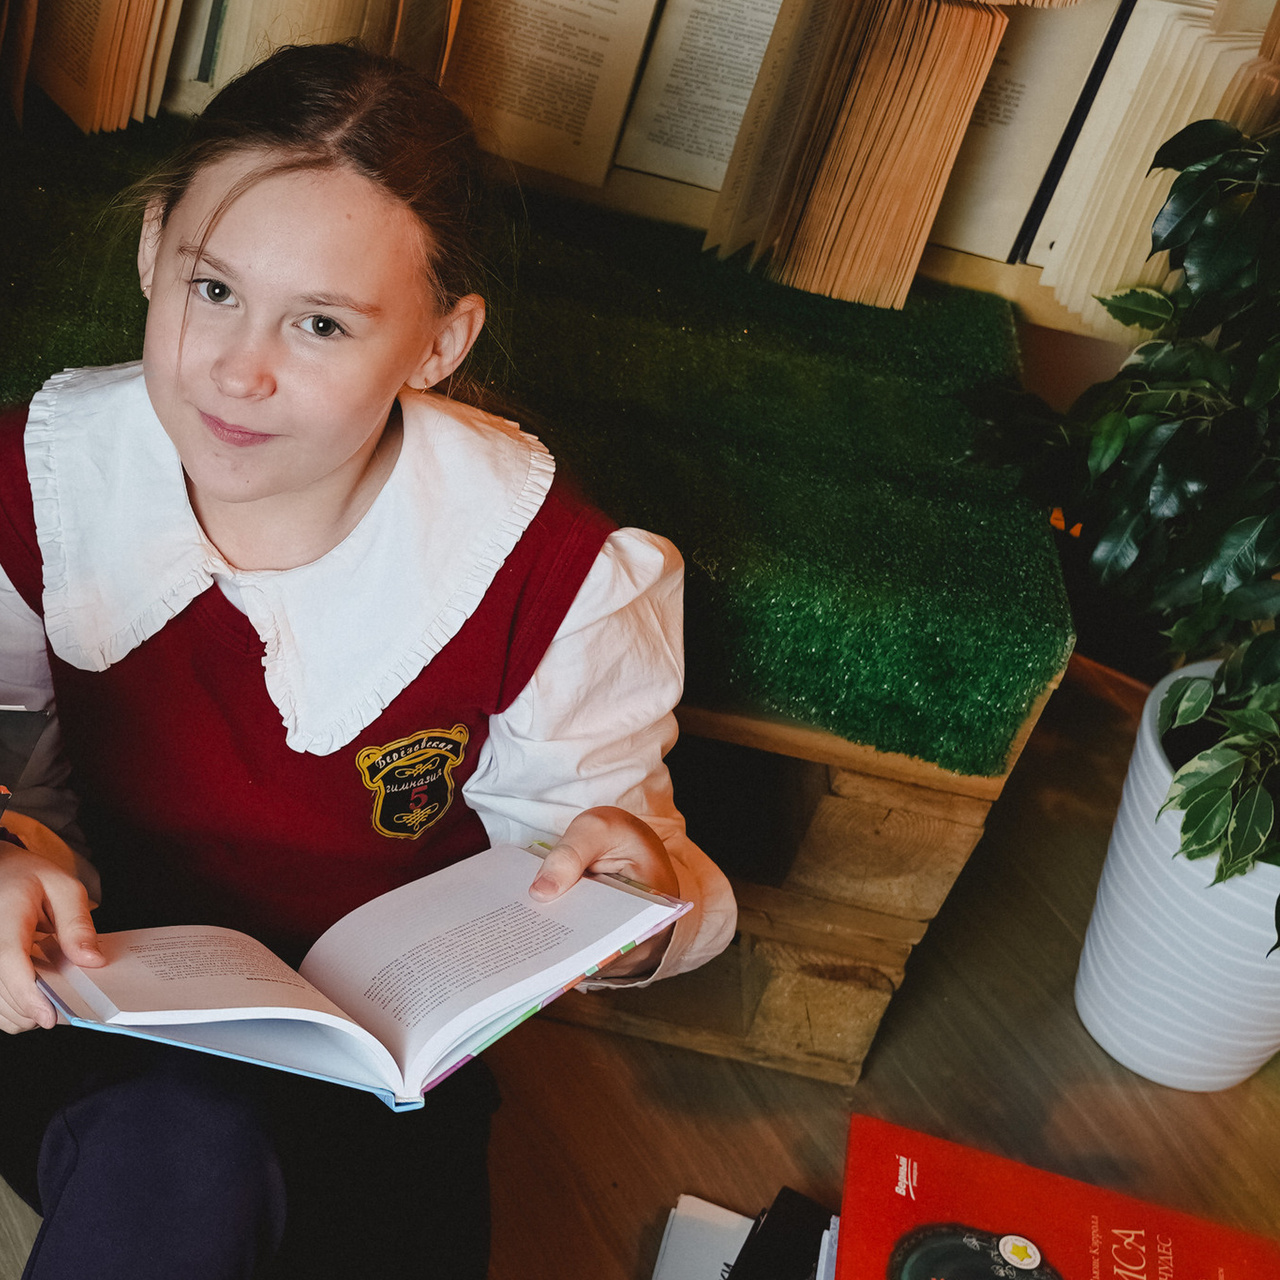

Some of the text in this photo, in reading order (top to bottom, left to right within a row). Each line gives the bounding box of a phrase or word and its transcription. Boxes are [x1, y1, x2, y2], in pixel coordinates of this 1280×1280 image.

[386, 768, 442, 793] гимназия
[409, 785, 428, 810] 5
[1156, 1233, 1173, 1280] ЧУДЕС
